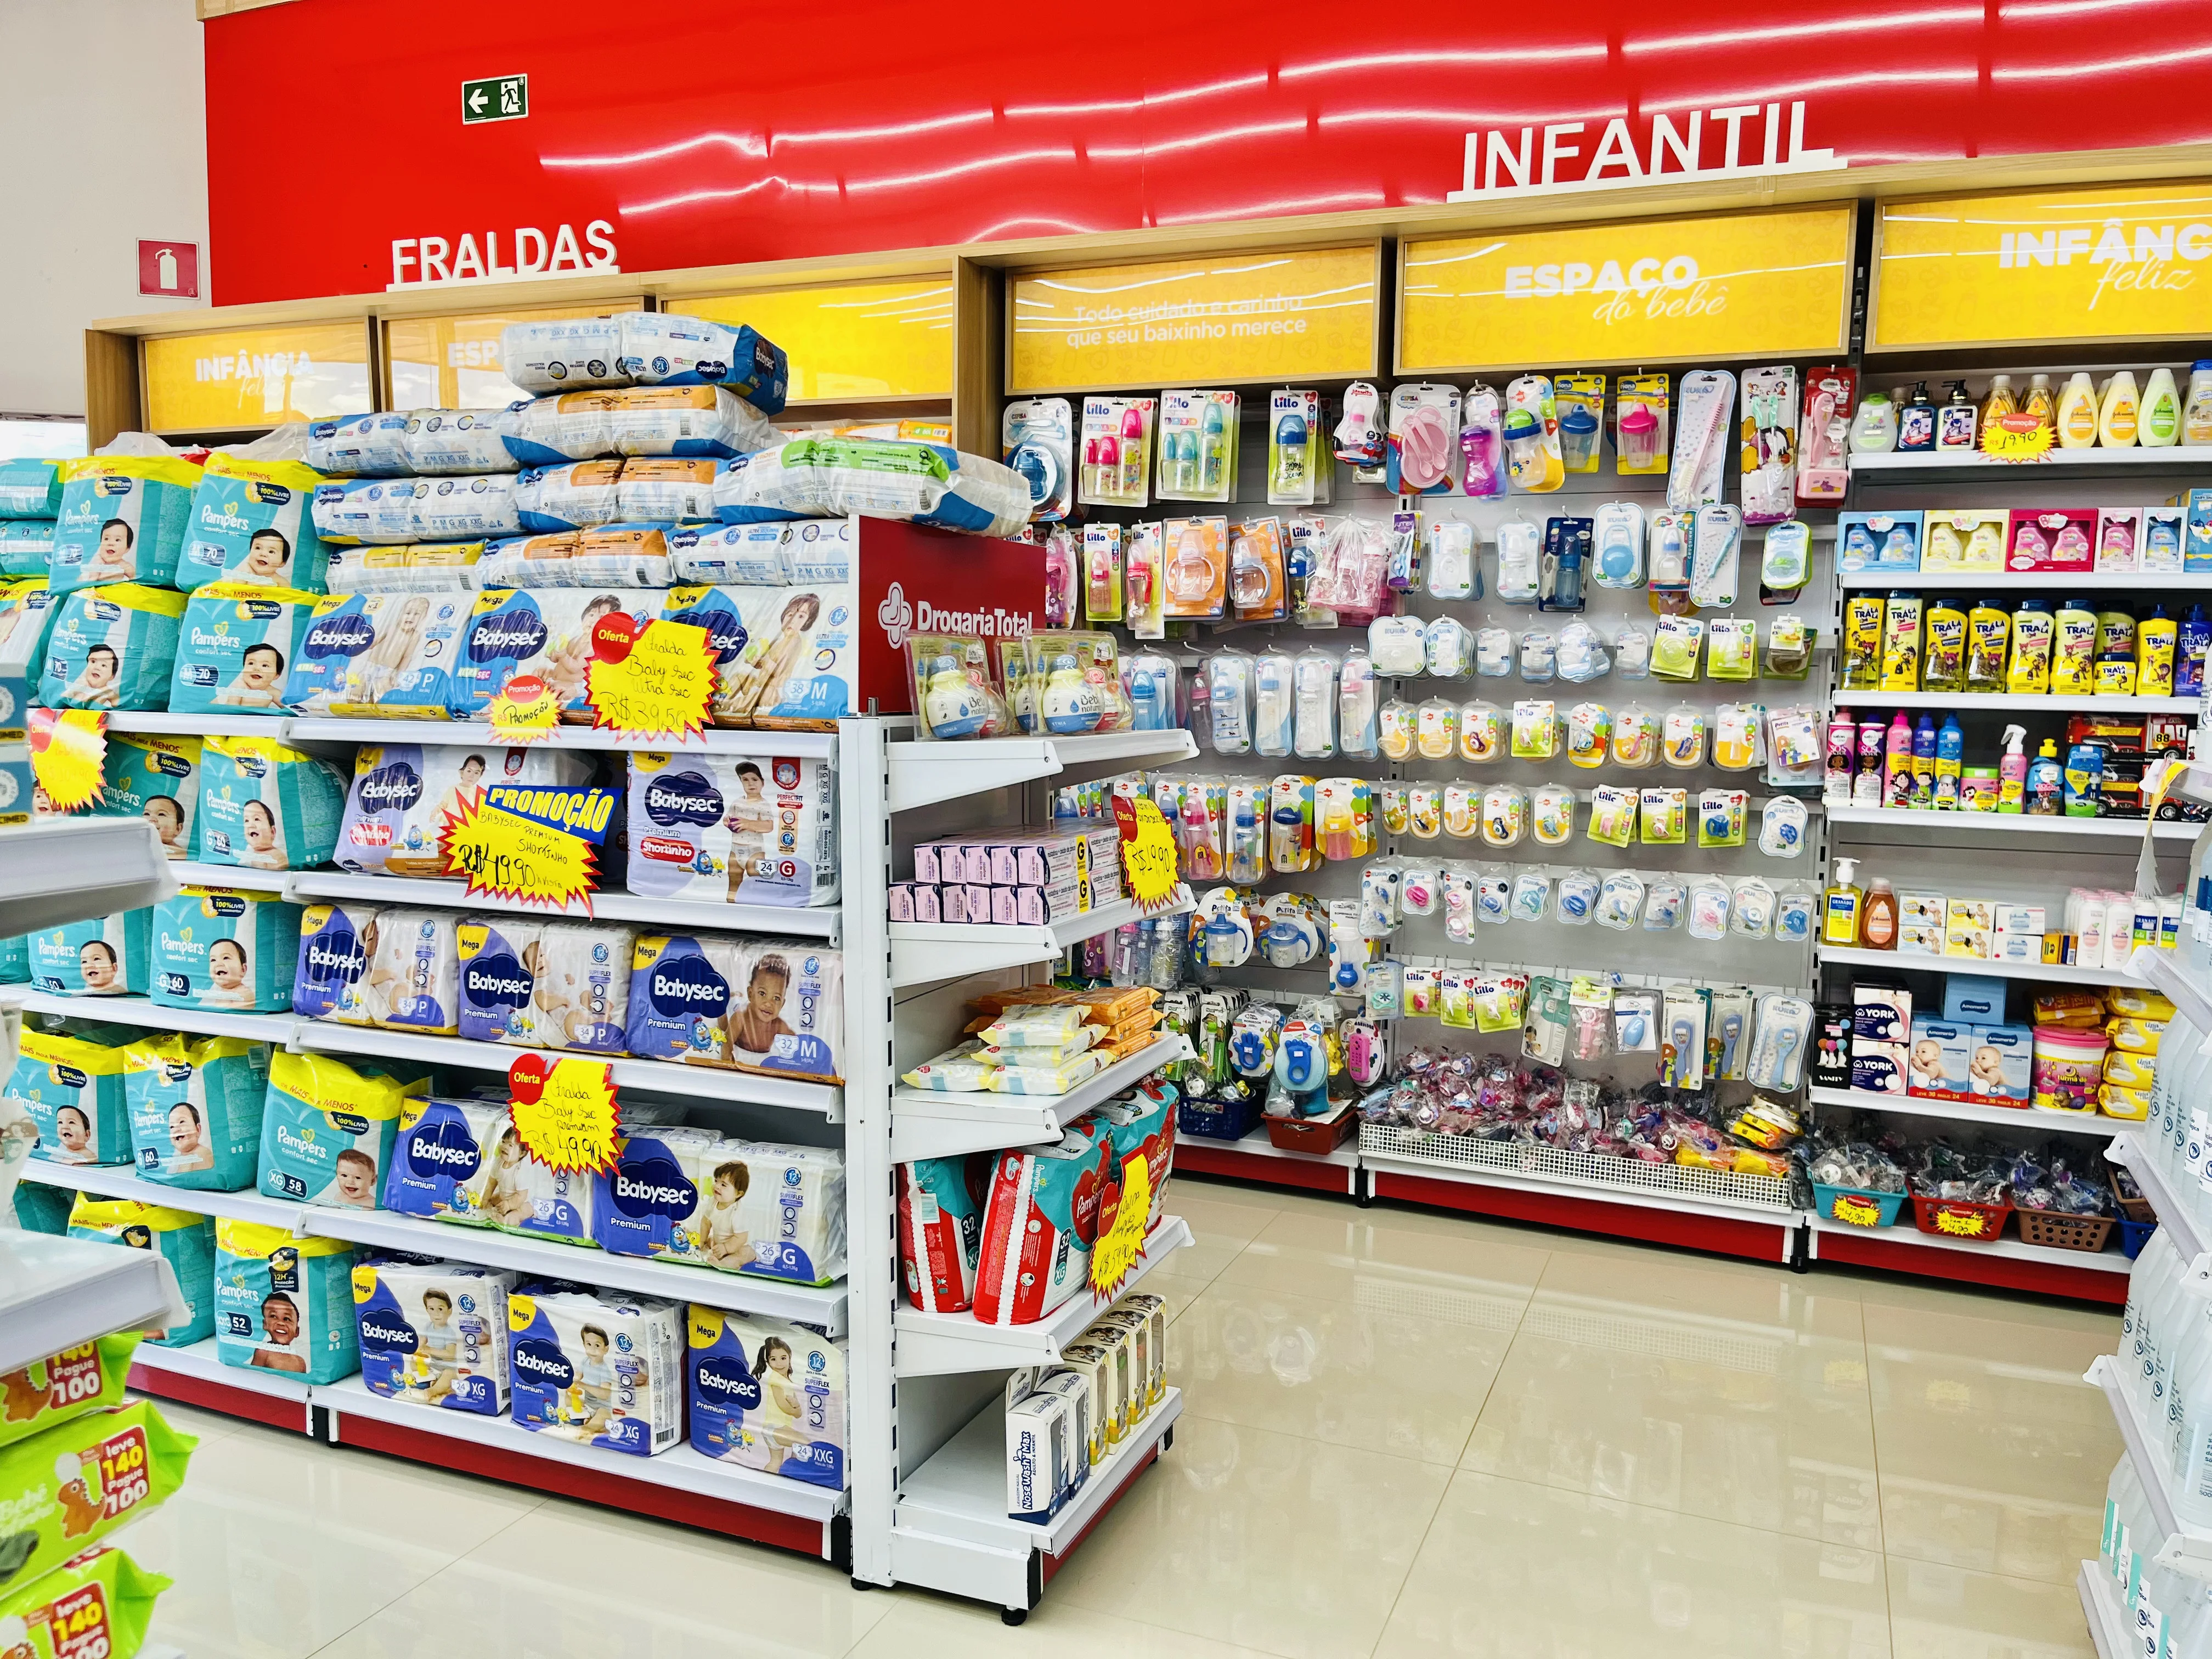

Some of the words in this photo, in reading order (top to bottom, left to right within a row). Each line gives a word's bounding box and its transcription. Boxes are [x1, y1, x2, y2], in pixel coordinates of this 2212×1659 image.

[1462, 101, 1834, 192] INFANTIL
[391, 219, 617, 285] FRALDAS
[1505, 256, 1699, 298] ESPAÇO
[2088, 255, 2195, 311] feliz
[1074, 302, 1122, 325] Todo
[1127, 297, 1205, 321] cuidado
[1227, 293, 1302, 314] carinho
[1593, 284, 1634, 325] do
[1646, 281, 1729, 320] bebê
[1066, 331, 1102, 349] que
[1107, 328, 1139, 344] seu
[1144, 320, 1226, 342] baixinho
[1232, 318, 1306, 338] merece
[448, 342, 499, 368] ESP
[195, 348, 314, 381] INFÂNCIA
[1087, 403, 1109, 416] Lillo
[1274, 397, 1297, 409] Lillo
[2002, 419, 2037, 428] Promoção
[201, 508, 250, 532] Pampers
[1087, 533, 1106, 541] Lillo
[1293, 528, 1311, 537] Lillo
[1658, 623, 1677, 633] Lillo
[191, 628, 241, 650] Pampers
[309, 628, 372, 650] Babysec
[472, 627, 544, 648] Babysec
[597, 629, 630, 645] Oferta
[507, 684, 541, 693] Promoção
[811, 681, 828, 700] M
[497, 713, 507, 722] R$
[2155, 733, 2170, 743] 88
[150, 741, 183, 753] MENOS
[648, 753, 665, 763] Mega
[362, 778, 419, 800] Babysec
[207, 788, 241, 815] Pampers
[650, 789, 718, 813] Babysec
[1643, 796, 1663, 804] Lillo
[1702, 801, 1723, 810] Lillo
[489, 788, 614, 833] PROMOÇÃO
[1117, 811, 1133, 821] Oferta
[479, 811, 521, 828] BABYSEC
[643, 826, 681, 838] Premium
[643, 840, 692, 857] Shortinho
[760, 862, 773, 872] 24
[783, 862, 793, 876] G
[204, 885, 233, 894] MENOS
[307, 916, 323, 926] Mega
[39, 937, 76, 957] Pampers
[161, 933, 205, 955] Pampers
[461, 940, 479, 950] Mega
[637, 946, 657, 958] Mega
[309, 946, 363, 970] Babysec
[172, 978, 184, 989] 60
[468, 970, 531, 995] Babysec
[1406, 973, 1425, 981] Lillo
[1443, 978, 1458, 988] Lillo
[301, 981, 331, 994] Premium
[654, 975, 724, 1002] Babysec
[1475, 985, 1494, 994] Lillo
[464, 1008, 498, 1020] Premium
[1865, 1008, 1895, 1019] YORK
[647, 1017, 686, 1031] Premium
[800, 1040, 817, 1058] M
[49, 1054, 75, 1066] MENOS
[1863, 1060, 1893, 1071] YORK
[514, 1071, 540, 1084] Oferta
[12, 1087, 53, 1116] Pampers
[290, 1084, 309, 1101] MAIS
[325, 1098, 355, 1112] MENOS
[134, 1110, 167, 1130] Pampers
[337, 1116, 353, 1125] 100%
[352, 1120, 368, 1129] LIVRE
[277, 1125, 328, 1159] Pampers
[411, 1137, 476, 1166] Babysec
[306, 1155, 319, 1165] sec
[269, 1170, 284, 1187] XG
[289, 1178, 302, 1192] 58
[402, 1177, 436, 1191] Premium
[617, 1176, 691, 1205] Babysec
[556, 1205, 567, 1221] G
[1102, 1202, 1117, 1218] Oferta
[611, 1217, 651, 1232] Premium
[963, 1215, 976, 1235] 32
[782, 1248, 795, 1265] G
[217, 1276, 262, 1302] Pampers
[355, 1282, 371, 1294] Mega
[513, 1308, 530, 1321] Mega
[233, 1317, 246, 1329] 52
[697, 1324, 716, 1338] Mega
[362, 1321, 414, 1344] Babysec
[363, 1352, 390, 1363] Premium
[517, 1350, 569, 1378] Babysec
[54, 1359, 96, 1380] Pague
[54, 1371, 100, 1404] 100
[472, 1382, 486, 1396] XG
[515, 1382, 544, 1394] Premium
[699, 1368, 757, 1398] Babysec
[805, 1378, 830, 1388] SUPERFLEX
[696, 1401, 727, 1415] Premium
[625, 1425, 639, 1440] XG
[106, 1435, 137, 1458] leve
[1022, 1430, 1031, 1457] Max
[103, 1445, 144, 1480] 140
[814, 1447, 834, 1464] XXG
[108, 1468, 144, 1492] Pague
[106, 1479, 149, 1515] 100
[57, 1592, 93, 1617] leve
[54, 1601, 103, 1642] 140
